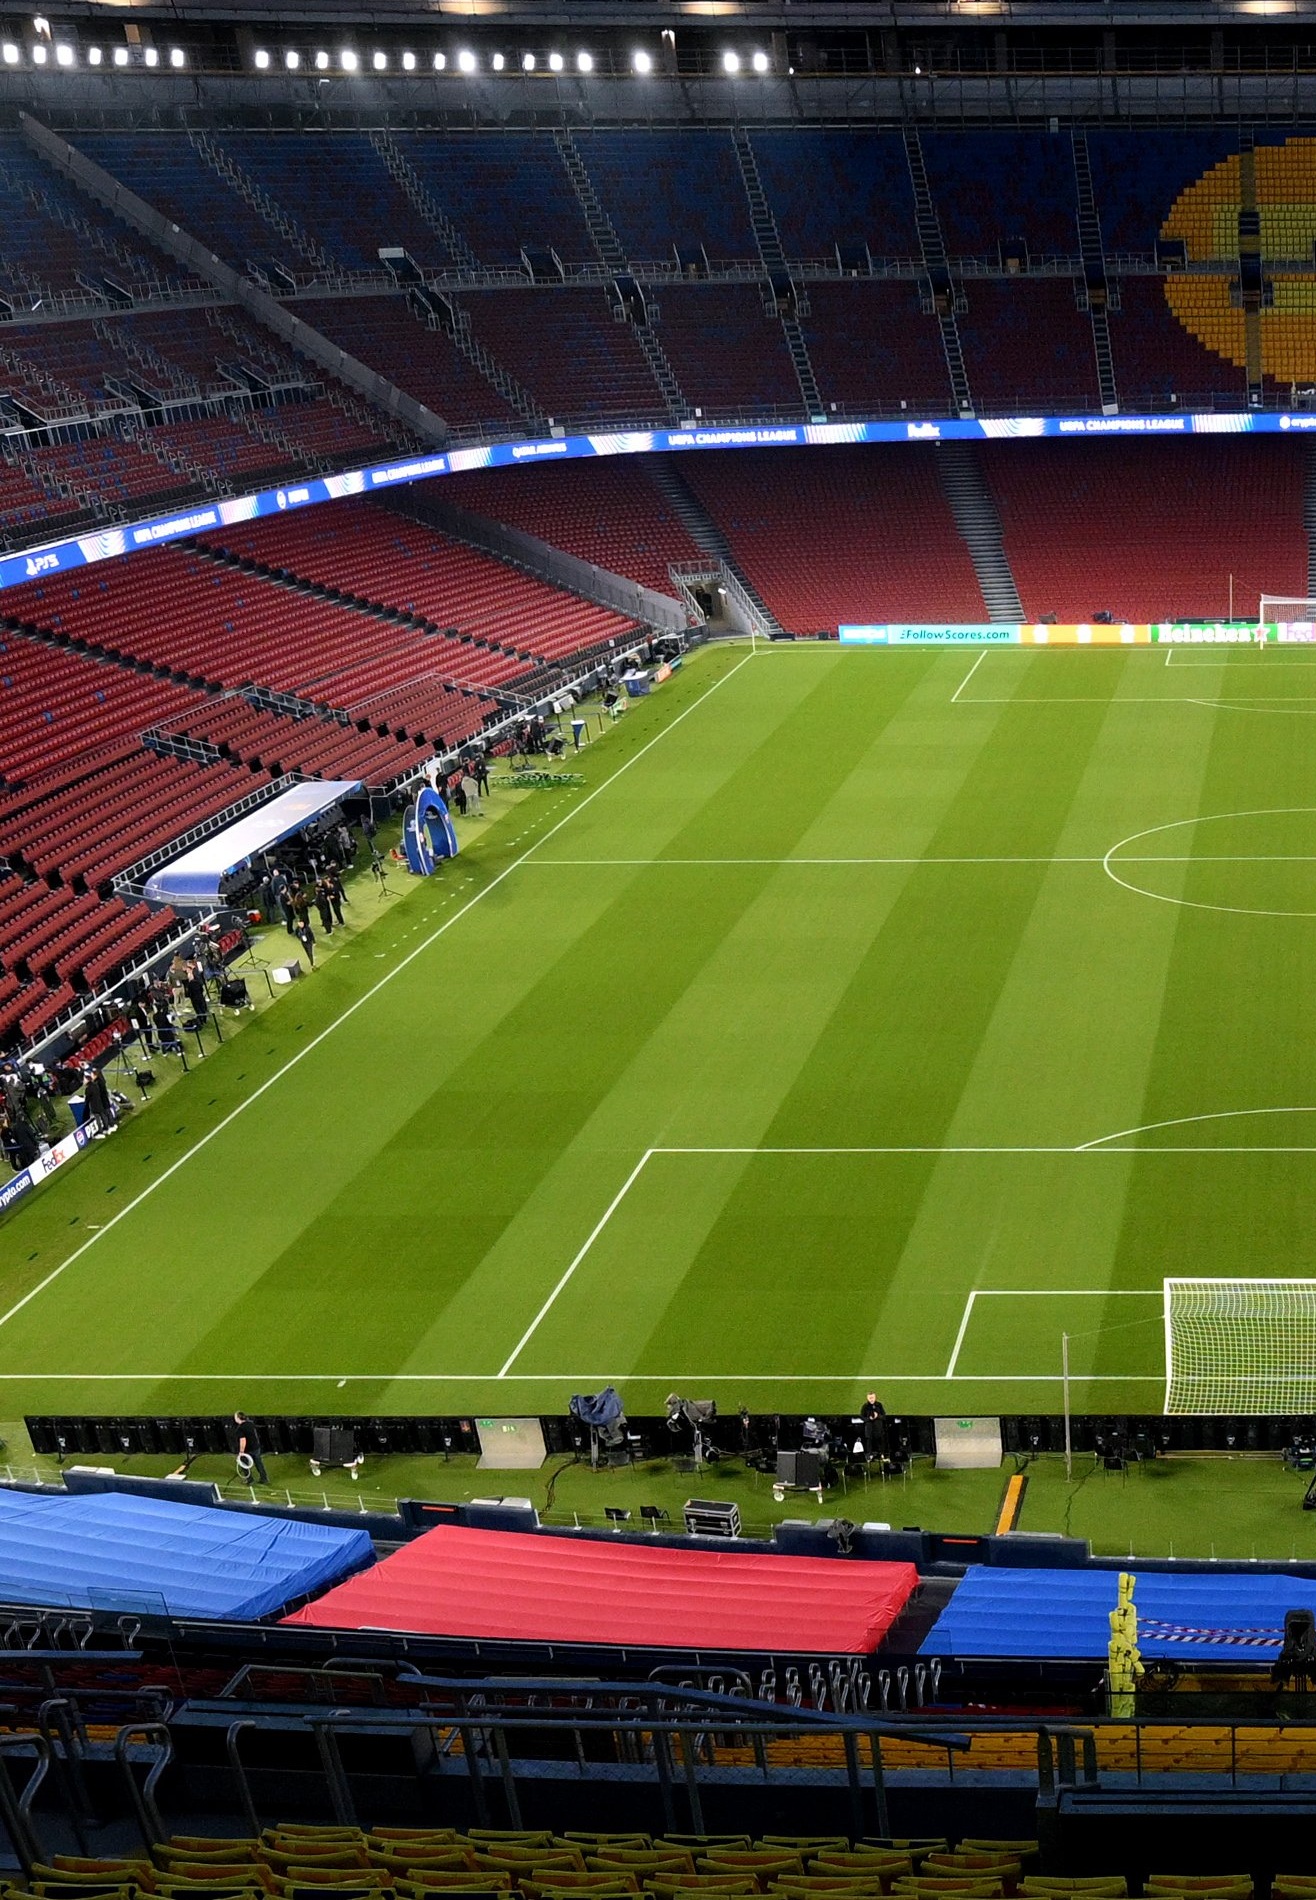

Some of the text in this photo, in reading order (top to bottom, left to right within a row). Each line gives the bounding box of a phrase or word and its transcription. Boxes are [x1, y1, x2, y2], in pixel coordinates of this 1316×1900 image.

[1060, 419, 1184, 431] UEFA CHAMPIONS LEAGUE
[668, 430, 797, 446] UEFA CHAMPIONS LEAGUE
[906, 629, 1010, 640] FollowScores.com
[1157, 622, 1252, 643] Heineken
[41, 1149, 66, 1174] FedEx
[0, 1174, 31, 1208] ypto.com
